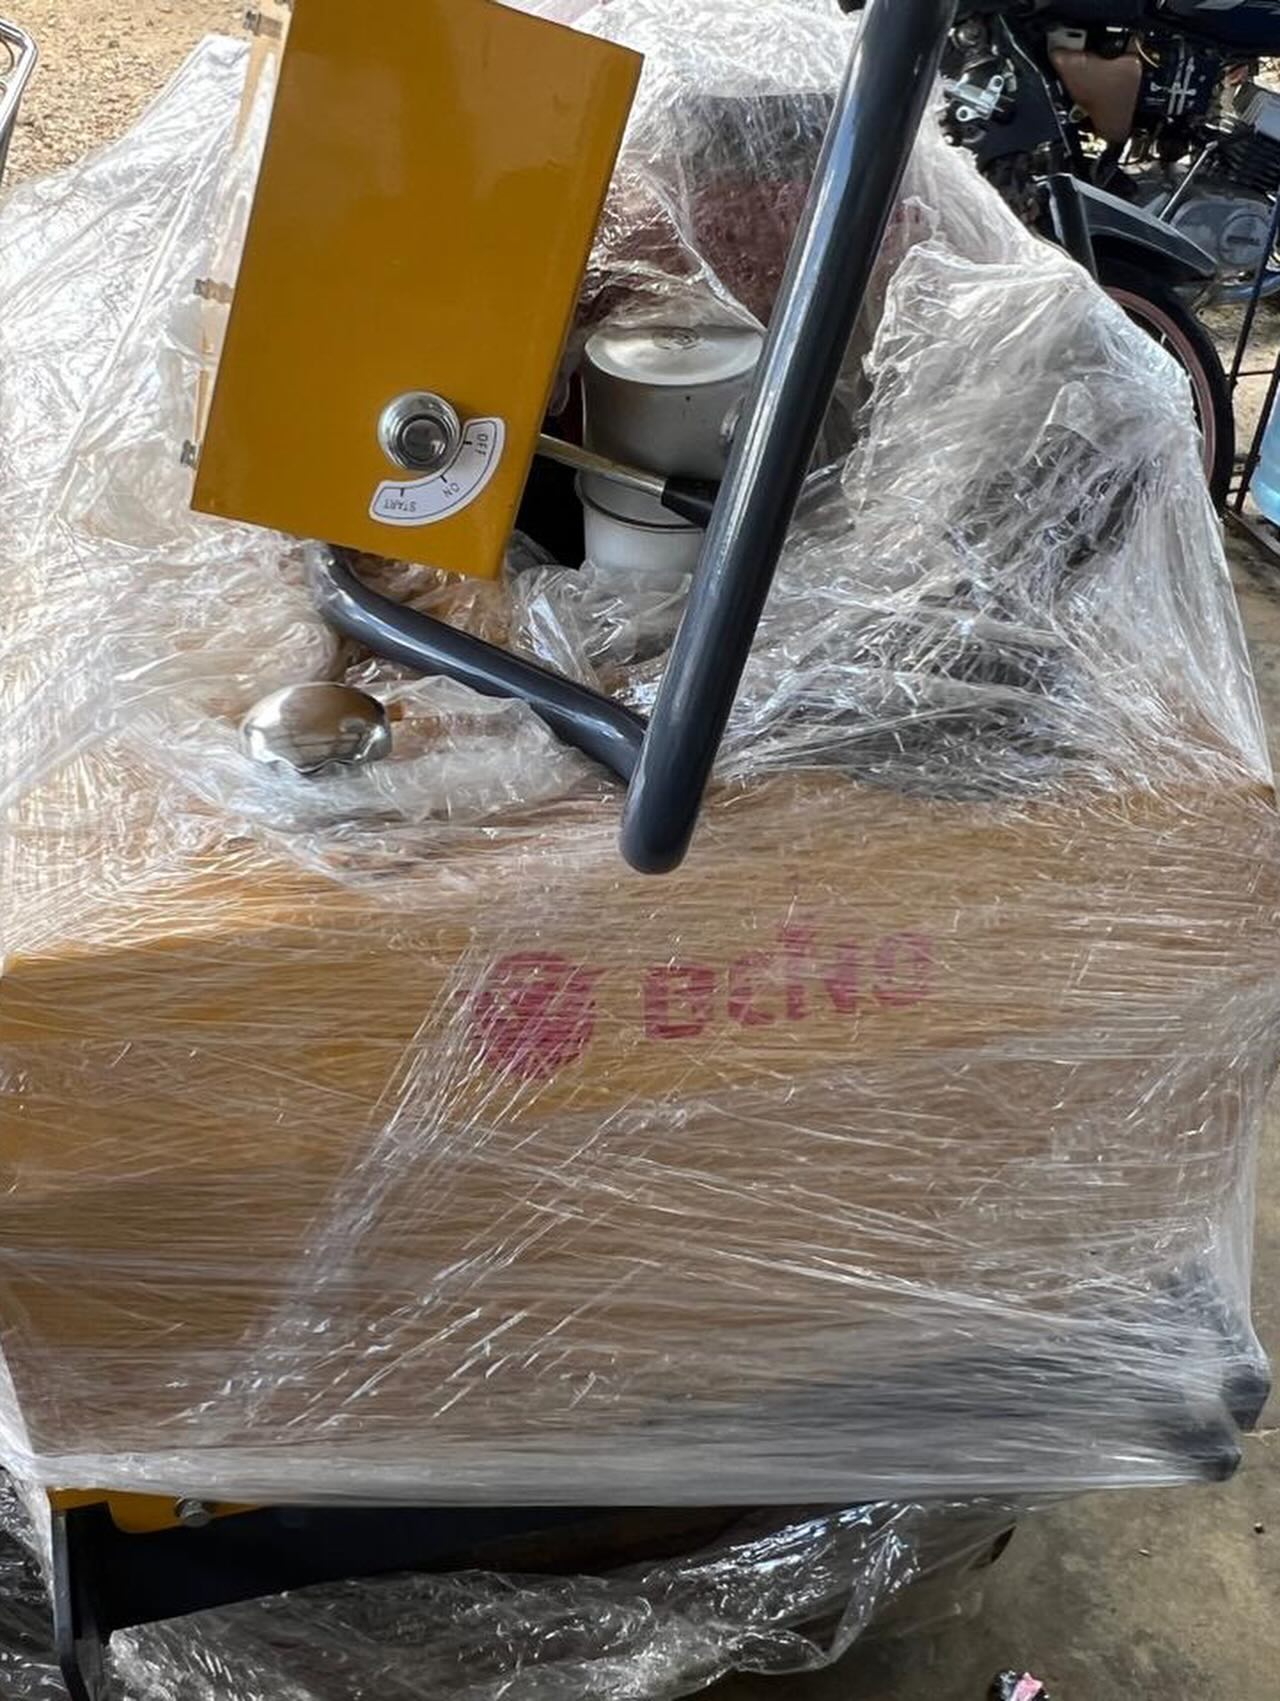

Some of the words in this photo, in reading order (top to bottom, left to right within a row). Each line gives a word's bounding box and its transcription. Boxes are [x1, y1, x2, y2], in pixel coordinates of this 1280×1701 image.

[475, 433, 489, 456] OFF
[442, 482, 460, 498] ON
[383, 498, 417, 512] START
